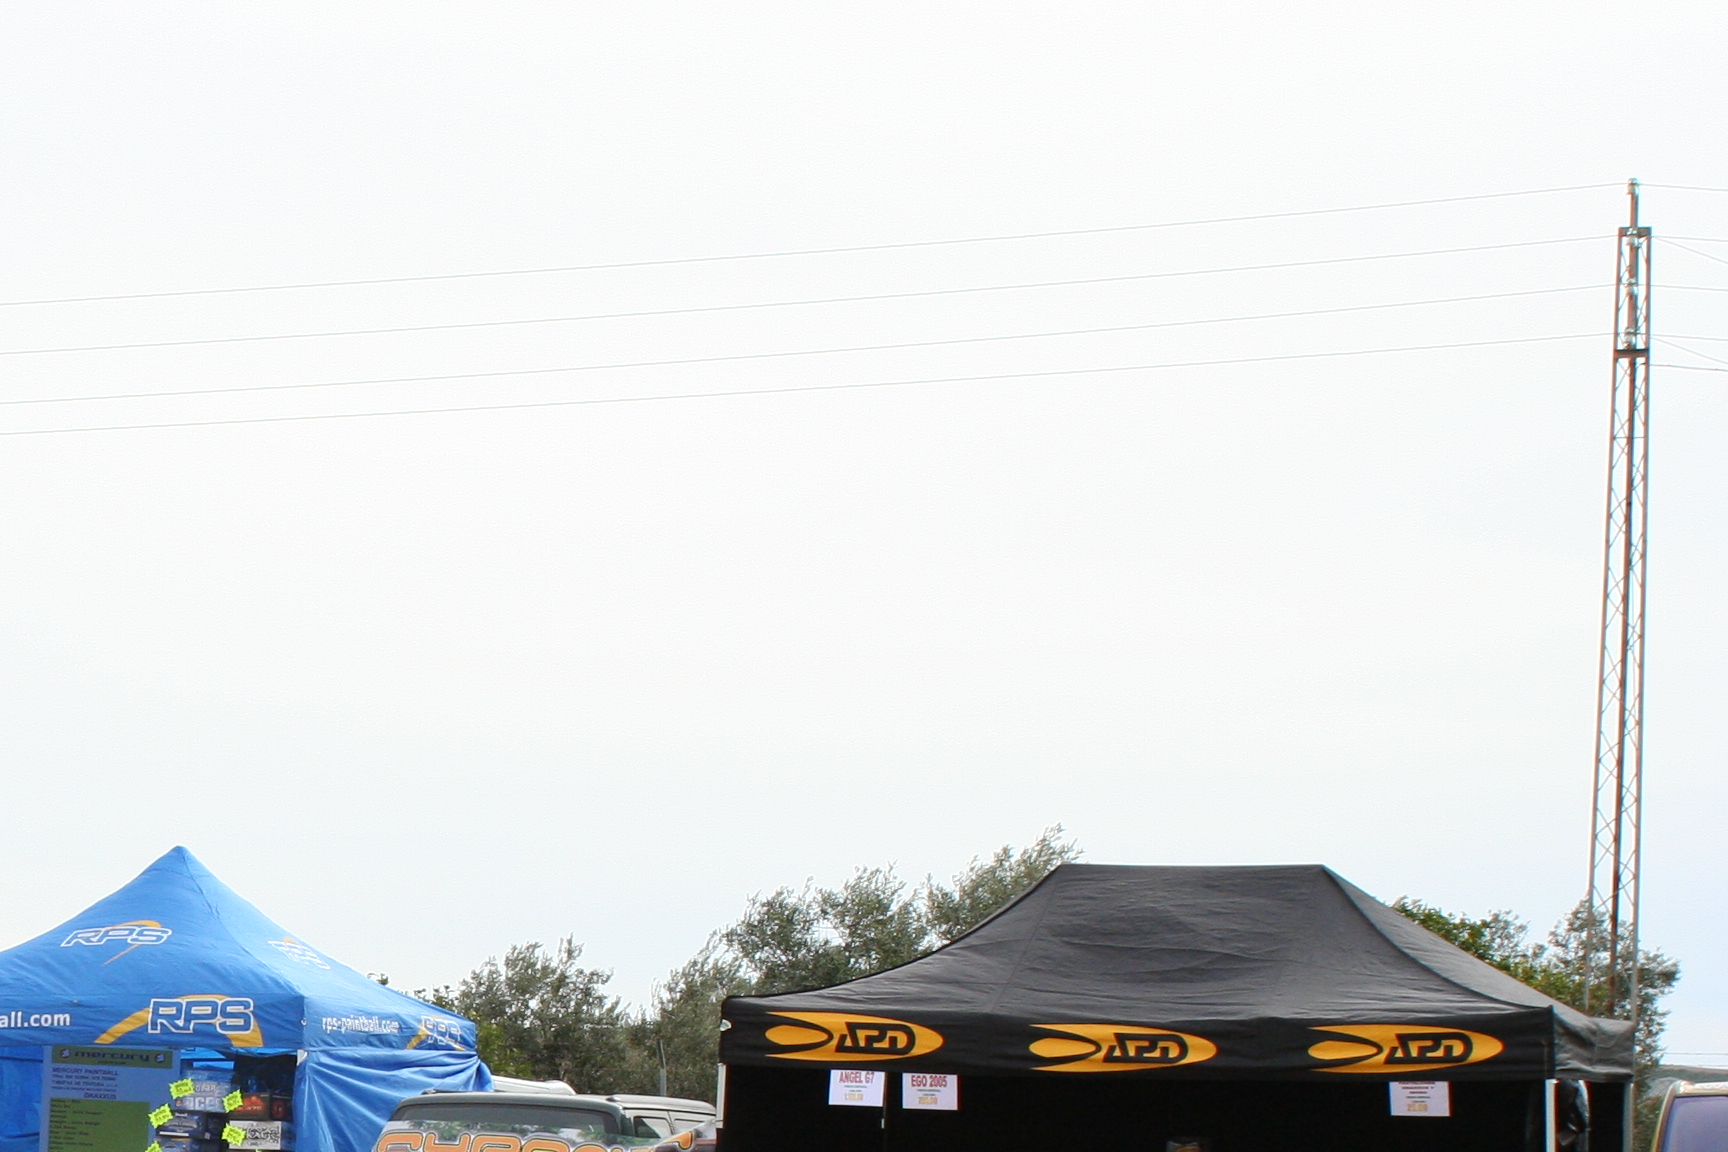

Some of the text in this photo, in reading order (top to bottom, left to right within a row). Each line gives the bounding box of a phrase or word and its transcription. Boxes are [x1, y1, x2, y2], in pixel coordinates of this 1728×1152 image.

[60, 926, 173, 947] RPS
[147, 998, 255, 1034] RPS
[839, 1071, 864, 1083] ANGEL
[911, 1075, 948, 1088] EGO 2005
